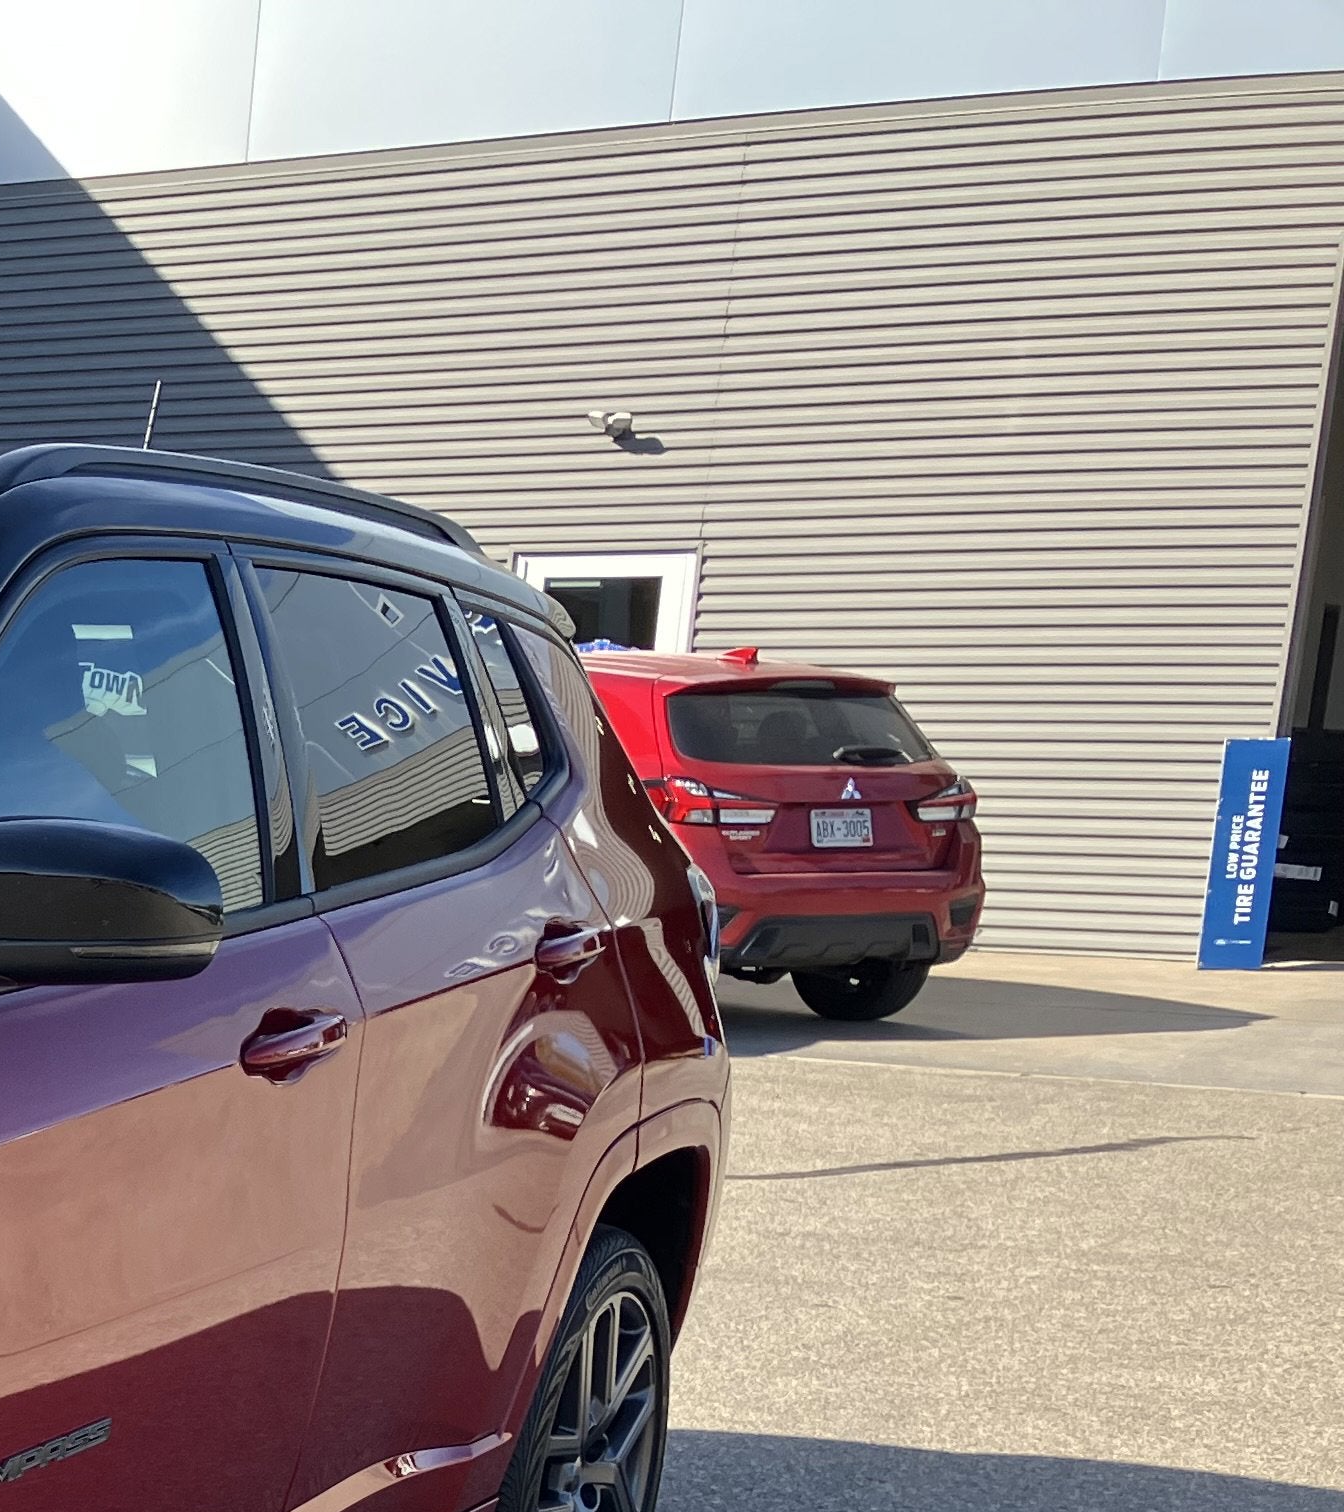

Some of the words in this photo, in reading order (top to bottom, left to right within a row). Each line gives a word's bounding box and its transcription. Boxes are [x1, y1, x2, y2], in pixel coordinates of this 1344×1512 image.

[1230, 814, 1245, 850] PRICE
[1239, 768, 1270, 881] GUARANTEE
[1225, 852, 1240, 879] LOW
[1233, 883, 1255, 926] TIRE
